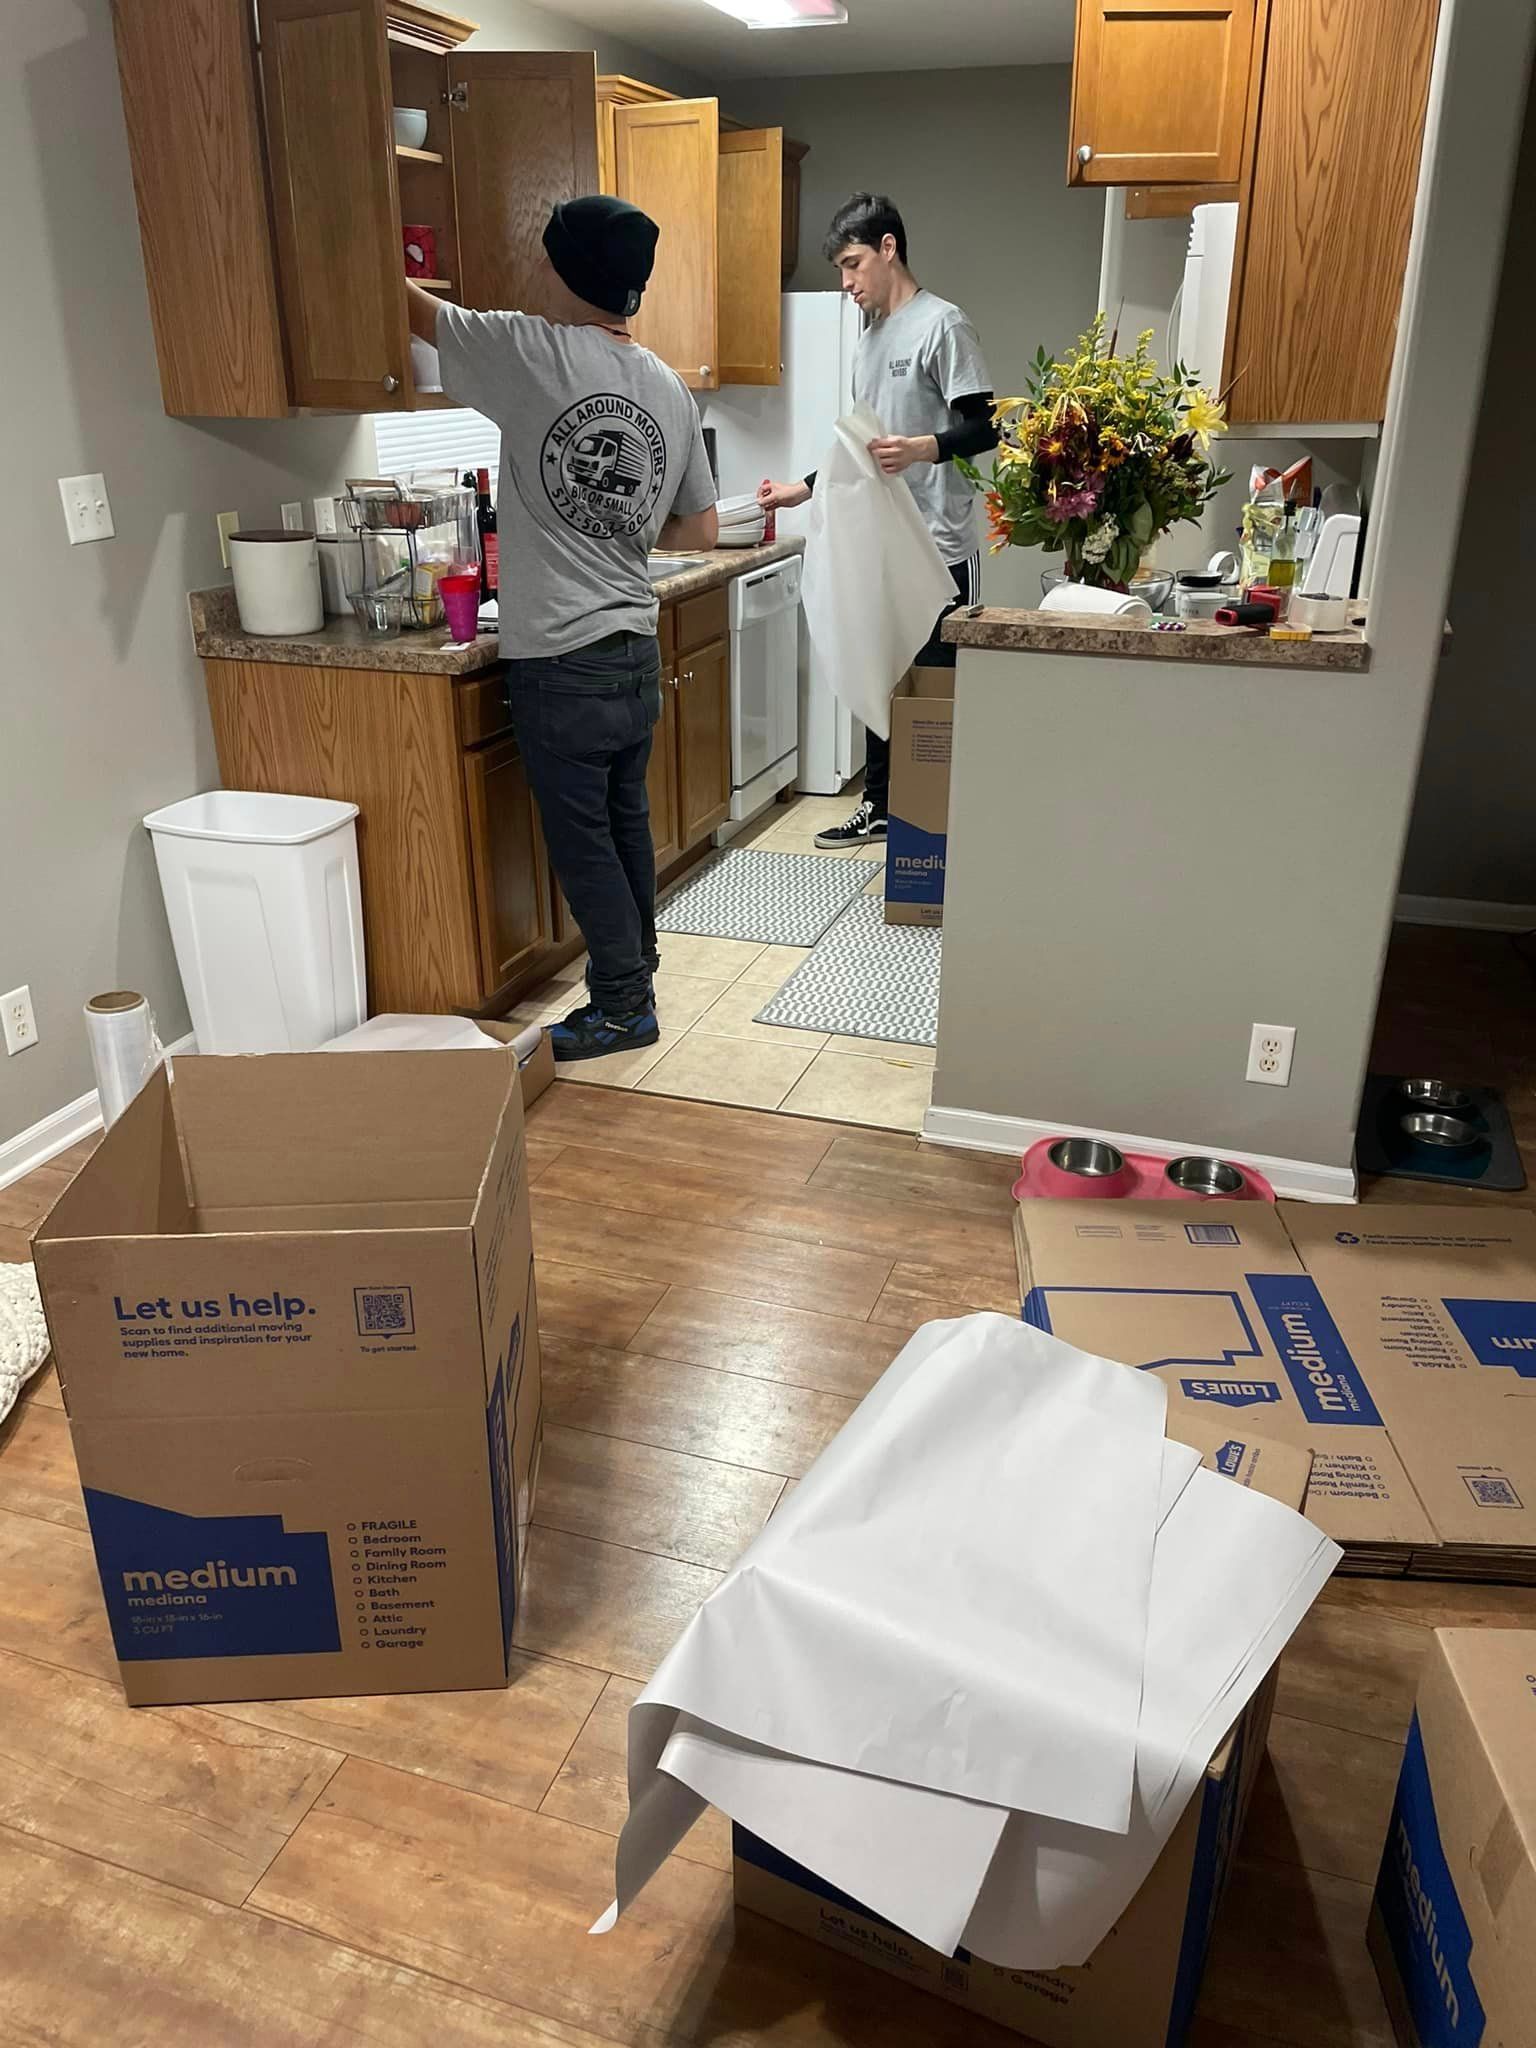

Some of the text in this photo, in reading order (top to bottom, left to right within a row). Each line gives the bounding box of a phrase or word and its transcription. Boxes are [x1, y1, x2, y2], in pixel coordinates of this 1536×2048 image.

[552, 399, 663, 476] ALL AROUND MOVERS
[572, 486, 632, 516] BIG OR SMALL
[896, 855, 946, 870] mediu
[114, 1292, 316, 1320] Let us help.
[120, 1322, 302, 1336] Scan to find additional moving
[122, 1334, 312, 1348] supplies and inspiration for your
[124, 1348, 189, 1359] new home.
[1281, 1314, 1347, 1411] medium
[1192, 1382, 1271, 1398] LOWE'S
[1337, 1374, 1360, 1412] mediana
[1221, 1444, 1242, 1473] LOWE'S
[1335, 1472, 1370, 1480] Dining
[1340, 1481, 1375, 1489] Family
[1330, 1490, 1379, 1499] Bedroom
[362, 1520, 417, 1530] FRAGILE
[363, 1534, 422, 1545] Bedroom
[364, 1547, 446, 1558] Family Room
[366, 1560, 446, 1572] Dining Room
[123, 1560, 298, 1592] medium
[368, 1574, 417, 1584] Kitchen
[369, 1588, 400, 1597] Bath
[128, 1594, 208, 1607] mediana
[371, 1600, 435, 1610] Basement
[373, 1614, 403, 1623] Attic
[374, 1626, 426, 1636] Laundry
[376, 1640, 424, 1649] Garage
[1400, 1818, 1460, 2029] medium
[820, 1908, 913, 1960] Let us help.
[1021, 1970, 1076, 1994] undry
[1010, 1974, 1069, 2005] Garage
